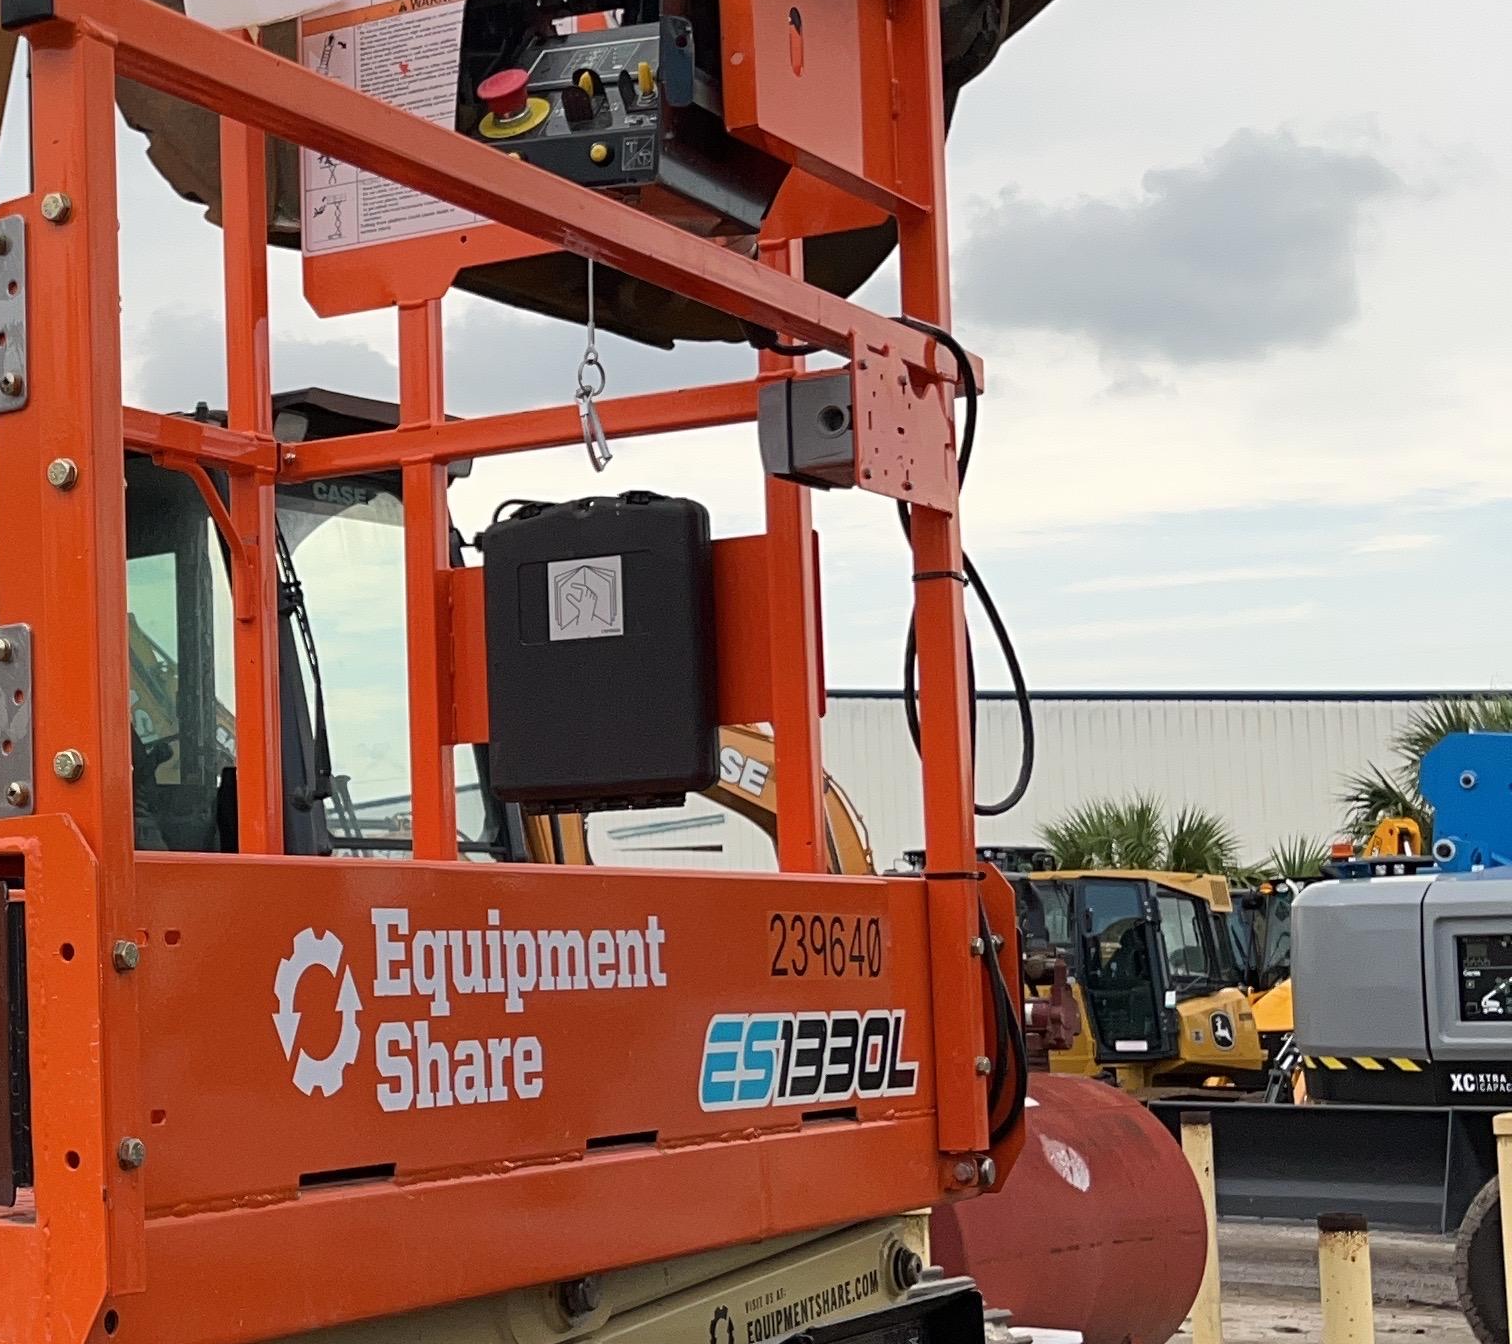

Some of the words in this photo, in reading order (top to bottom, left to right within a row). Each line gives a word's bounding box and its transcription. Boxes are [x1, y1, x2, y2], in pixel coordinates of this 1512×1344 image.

[312, 481, 368, 505] CASE
[371, 908, 667, 1017] Equipment
[769, 912, 882, 978] 239640
[375, 1020, 544, 1112] Share
[698, 1009, 920, 1112] ES1330L
[1450, 1072, 1476, 1093] XC
[745, 1296, 763, 1314] VISIT
[746, 1269, 879, 1344] EQUIPMENTSHARE.COM
